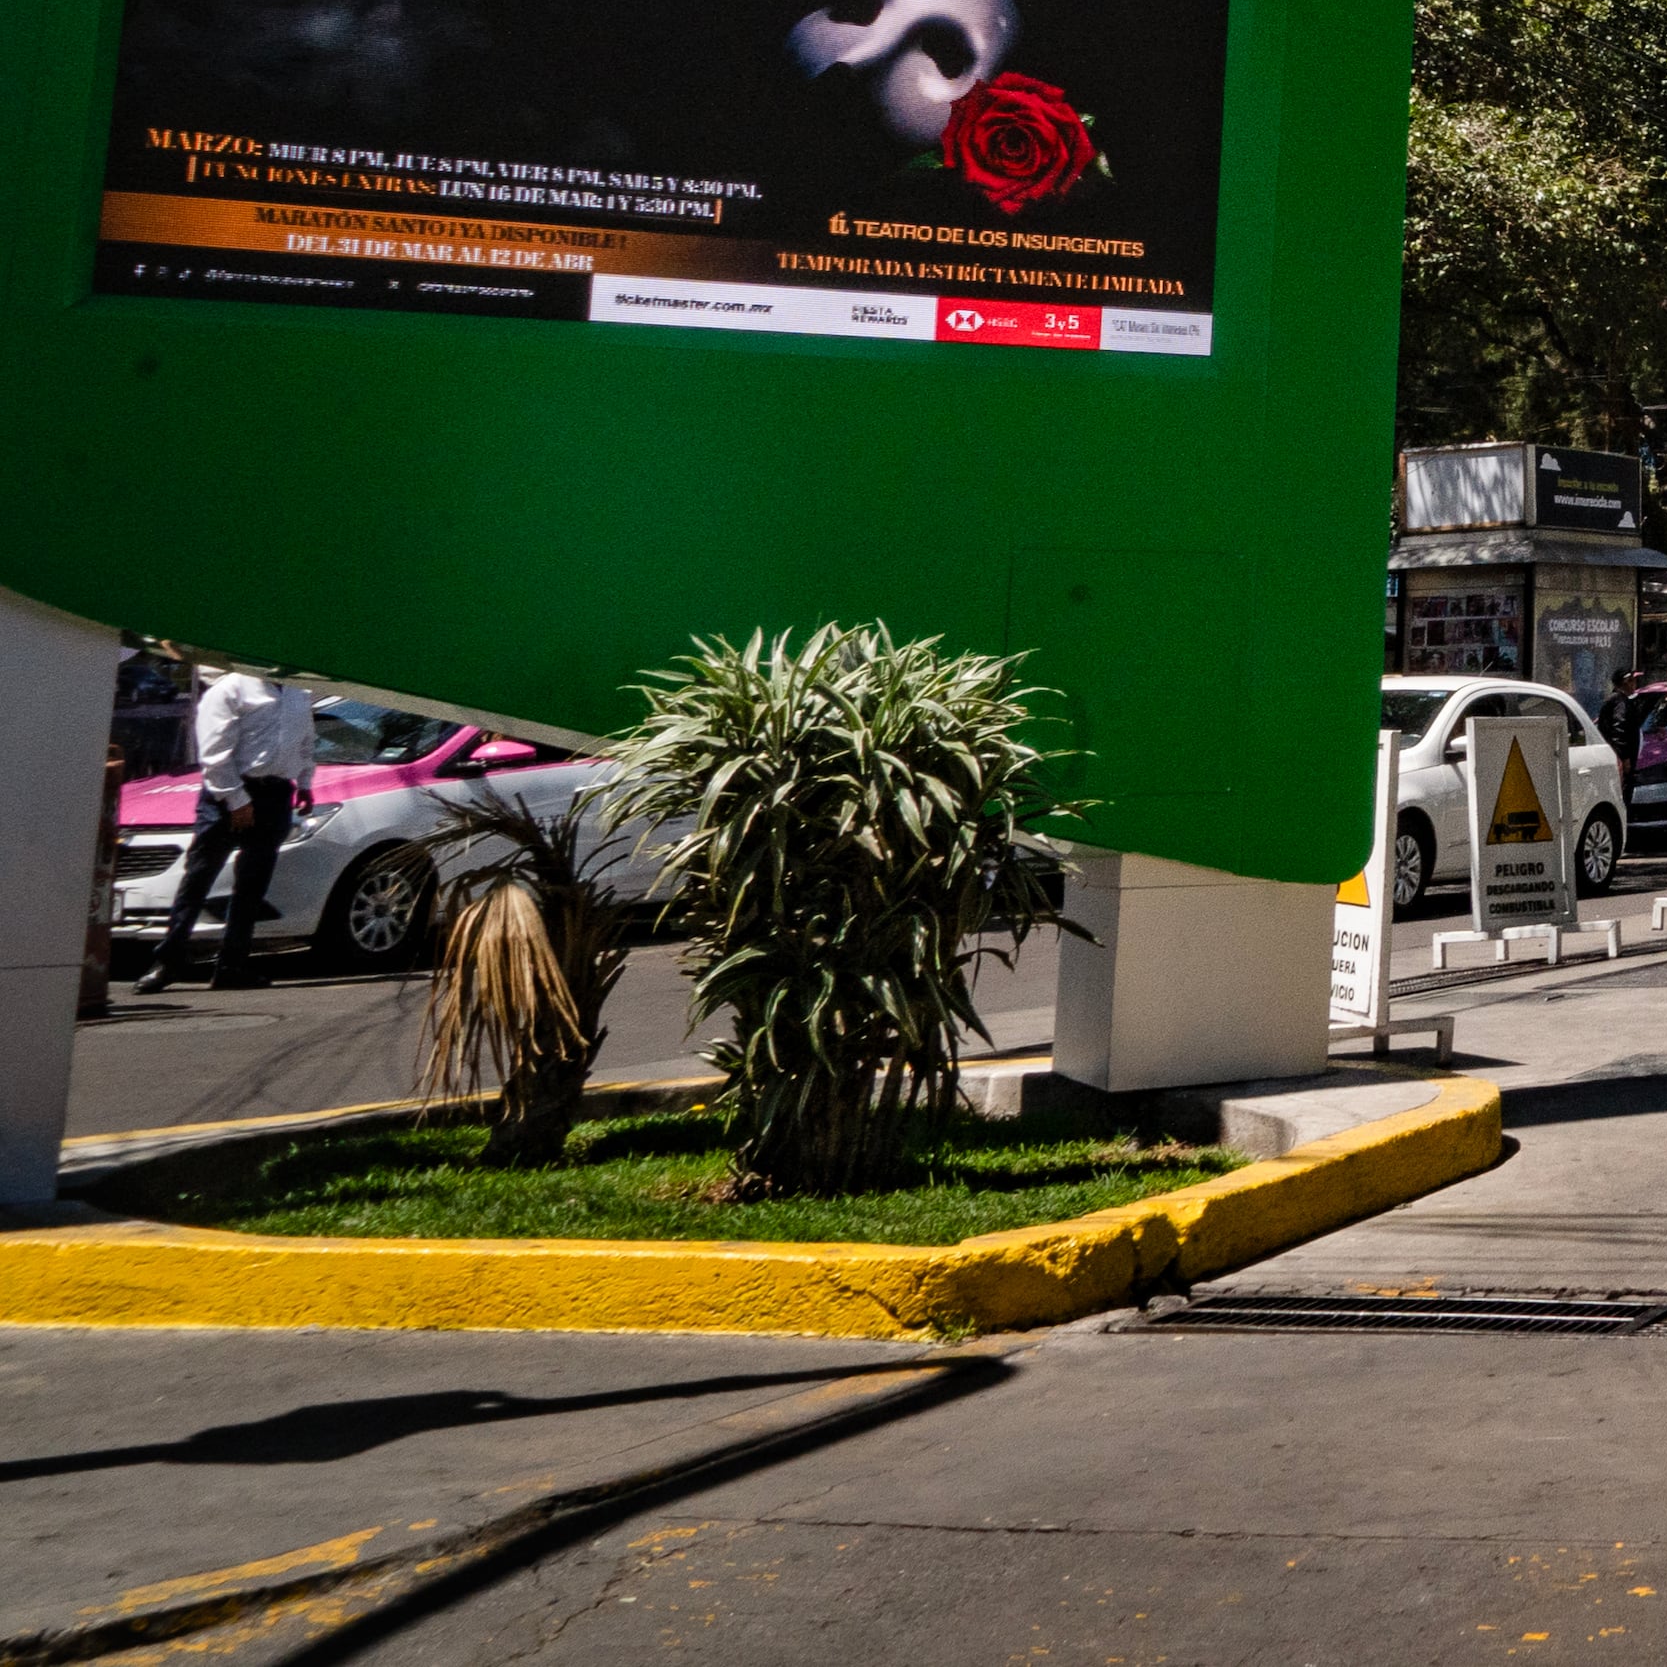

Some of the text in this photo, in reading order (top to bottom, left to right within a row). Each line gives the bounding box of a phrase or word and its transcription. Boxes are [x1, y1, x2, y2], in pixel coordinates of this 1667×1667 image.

[146, 127, 263, 156] MARZO:
[440, 180, 485, 200] LUN
[514, 186, 547, 204] DE
[254, 206, 367, 232] MARATÓN
[372, 215, 447, 235] SANTO
[286, 233, 336, 254] DEL
[365, 239, 397, 258] DE
[401, 241, 452, 263] MAR
[456, 246, 487, 264] AL
[514, 250, 545, 268] DE
[551, 253, 595, 272] ABR
[854, 220, 933, 241] TEATRO
[936, 227, 965, 243] DE
[969, 230, 1008, 248] LOS
[1012, 232, 1144, 259] INSURGENTES
[776, 251, 914, 279] TEMPORADA
[1092, 271, 1186, 296] LIMITADA
[1549, 618, 1620, 632] CONCURSO ESCOLAR
[1495, 862, 1545, 877] PELIGRO
[1486, 881, 1555, 896] DESCARGANDO
[1489, 899, 1555, 914] COMBUSTIBLE
